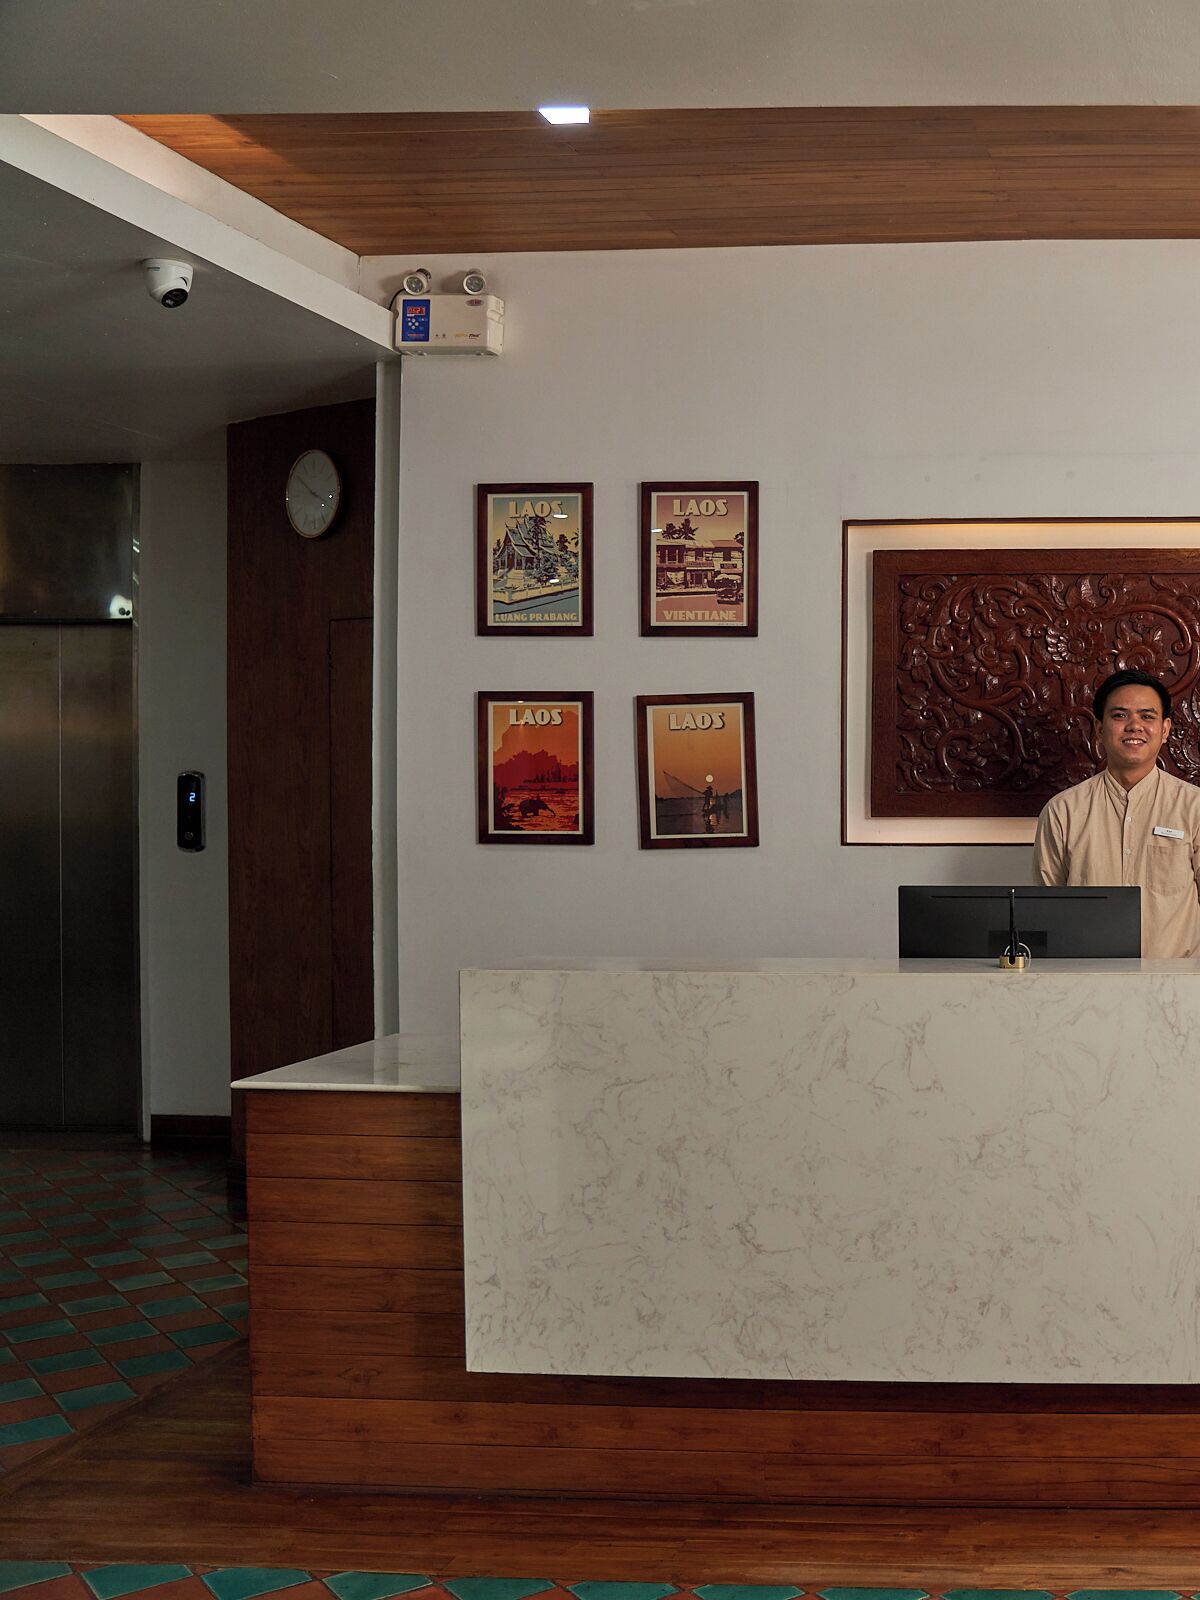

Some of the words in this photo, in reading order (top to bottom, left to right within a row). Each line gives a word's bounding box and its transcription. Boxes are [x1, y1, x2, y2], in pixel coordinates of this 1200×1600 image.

[508, 500, 564, 519] LAOS
[672, 499, 728, 517] LAOS
[495, 613, 528, 622] LUANG
[529, 612, 577, 621] PRABANG
[663, 610, 737, 621] VIENTIANE
[509, 708, 563, 726] LAOS
[668, 712, 725, 730] LAOS
[189, 792, 196, 802] 2
